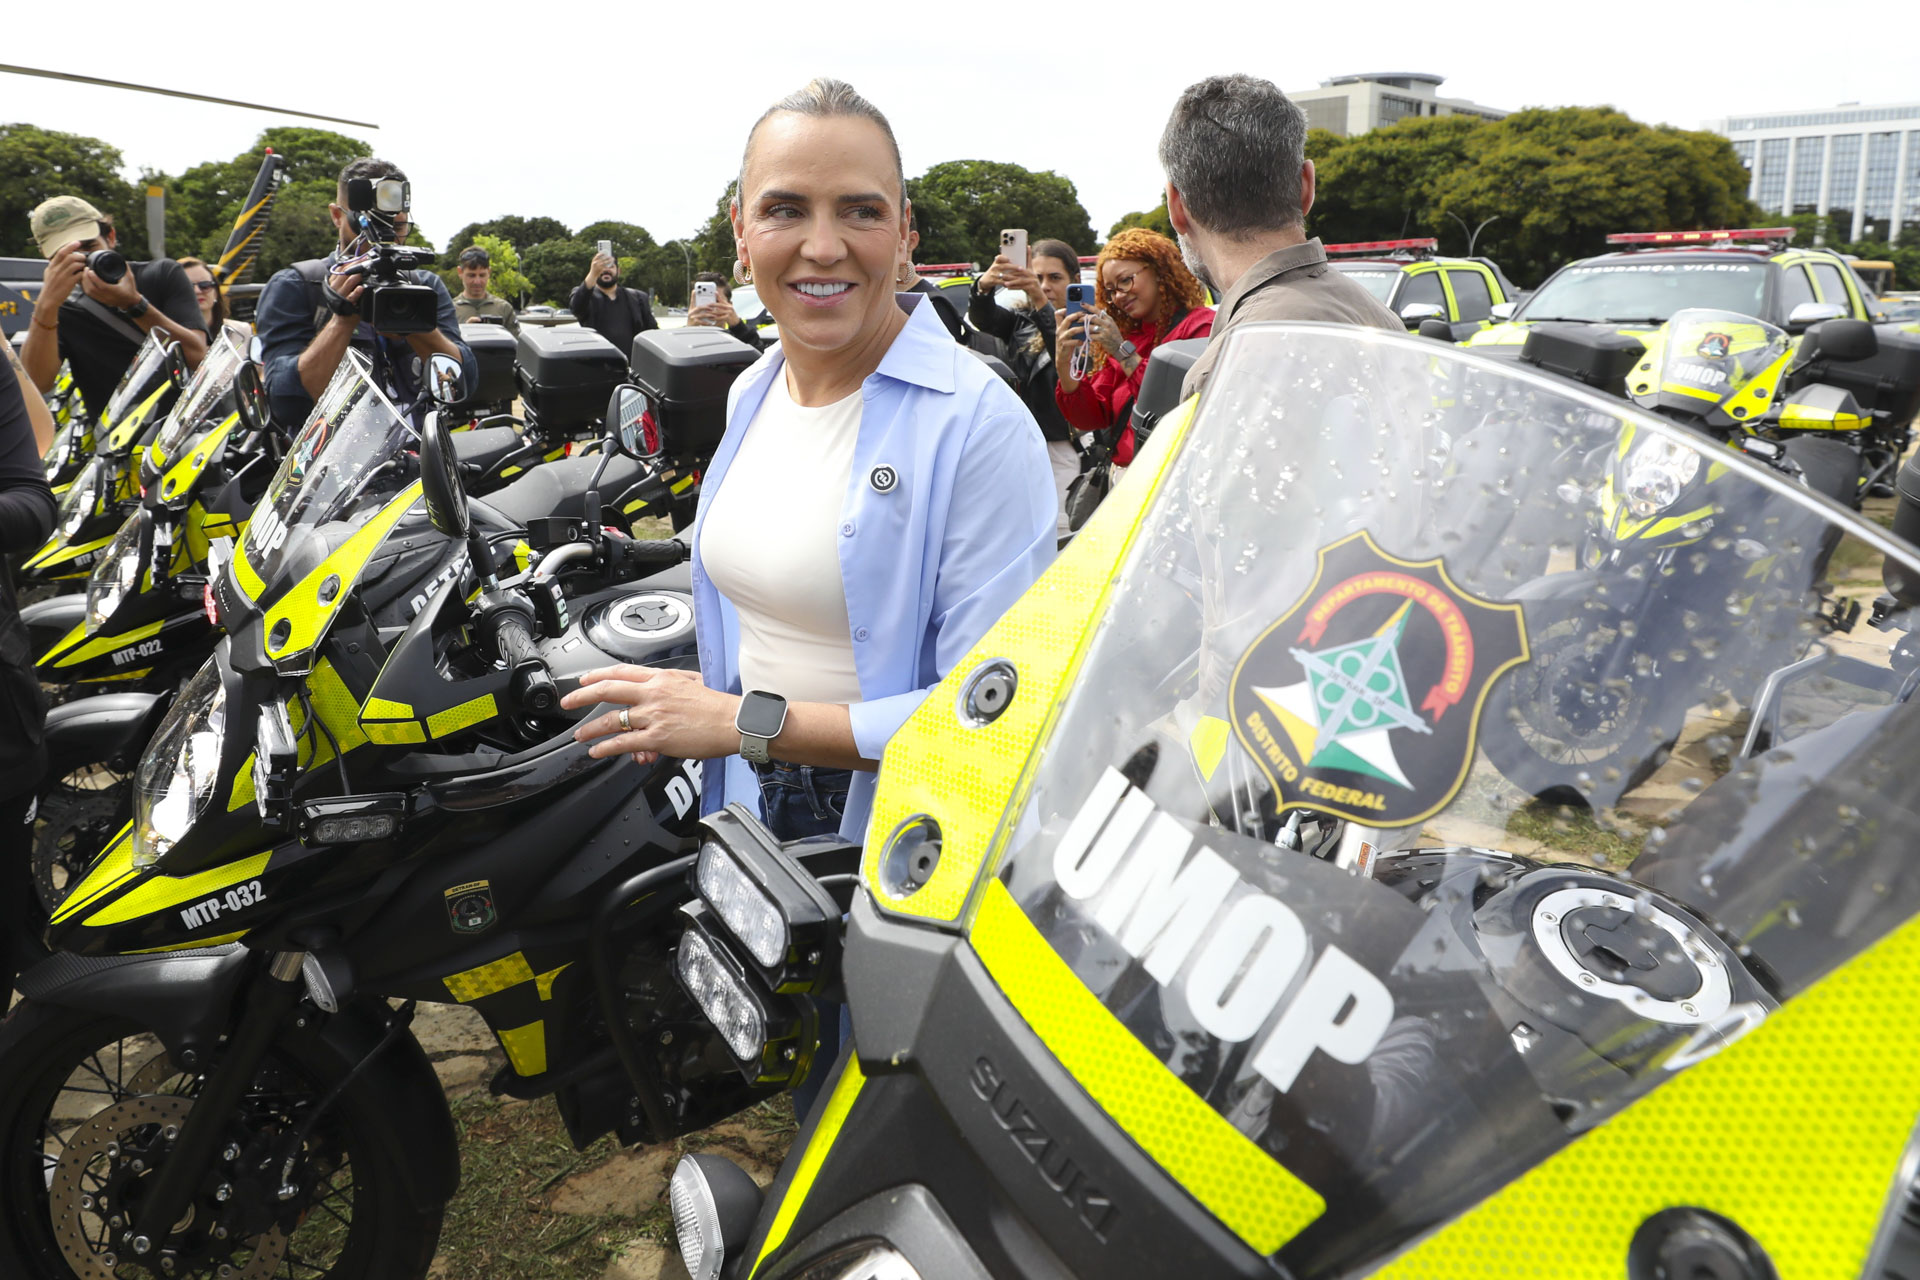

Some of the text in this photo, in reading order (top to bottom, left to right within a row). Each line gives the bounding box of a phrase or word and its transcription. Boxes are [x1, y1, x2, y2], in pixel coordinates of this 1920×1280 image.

[1313, 577, 1427, 622] DEPARTAMENTO
[1427, 594, 1449, 614] DE
[111, 640, 163, 666] MTP-022
[1246, 711, 1386, 811] DISTRITO FEDERAL
[180, 880, 267, 930] MTP-032
[1053, 764, 1395, 1094] UMOP
[969, 1056, 1120, 1245] SUZUKI
